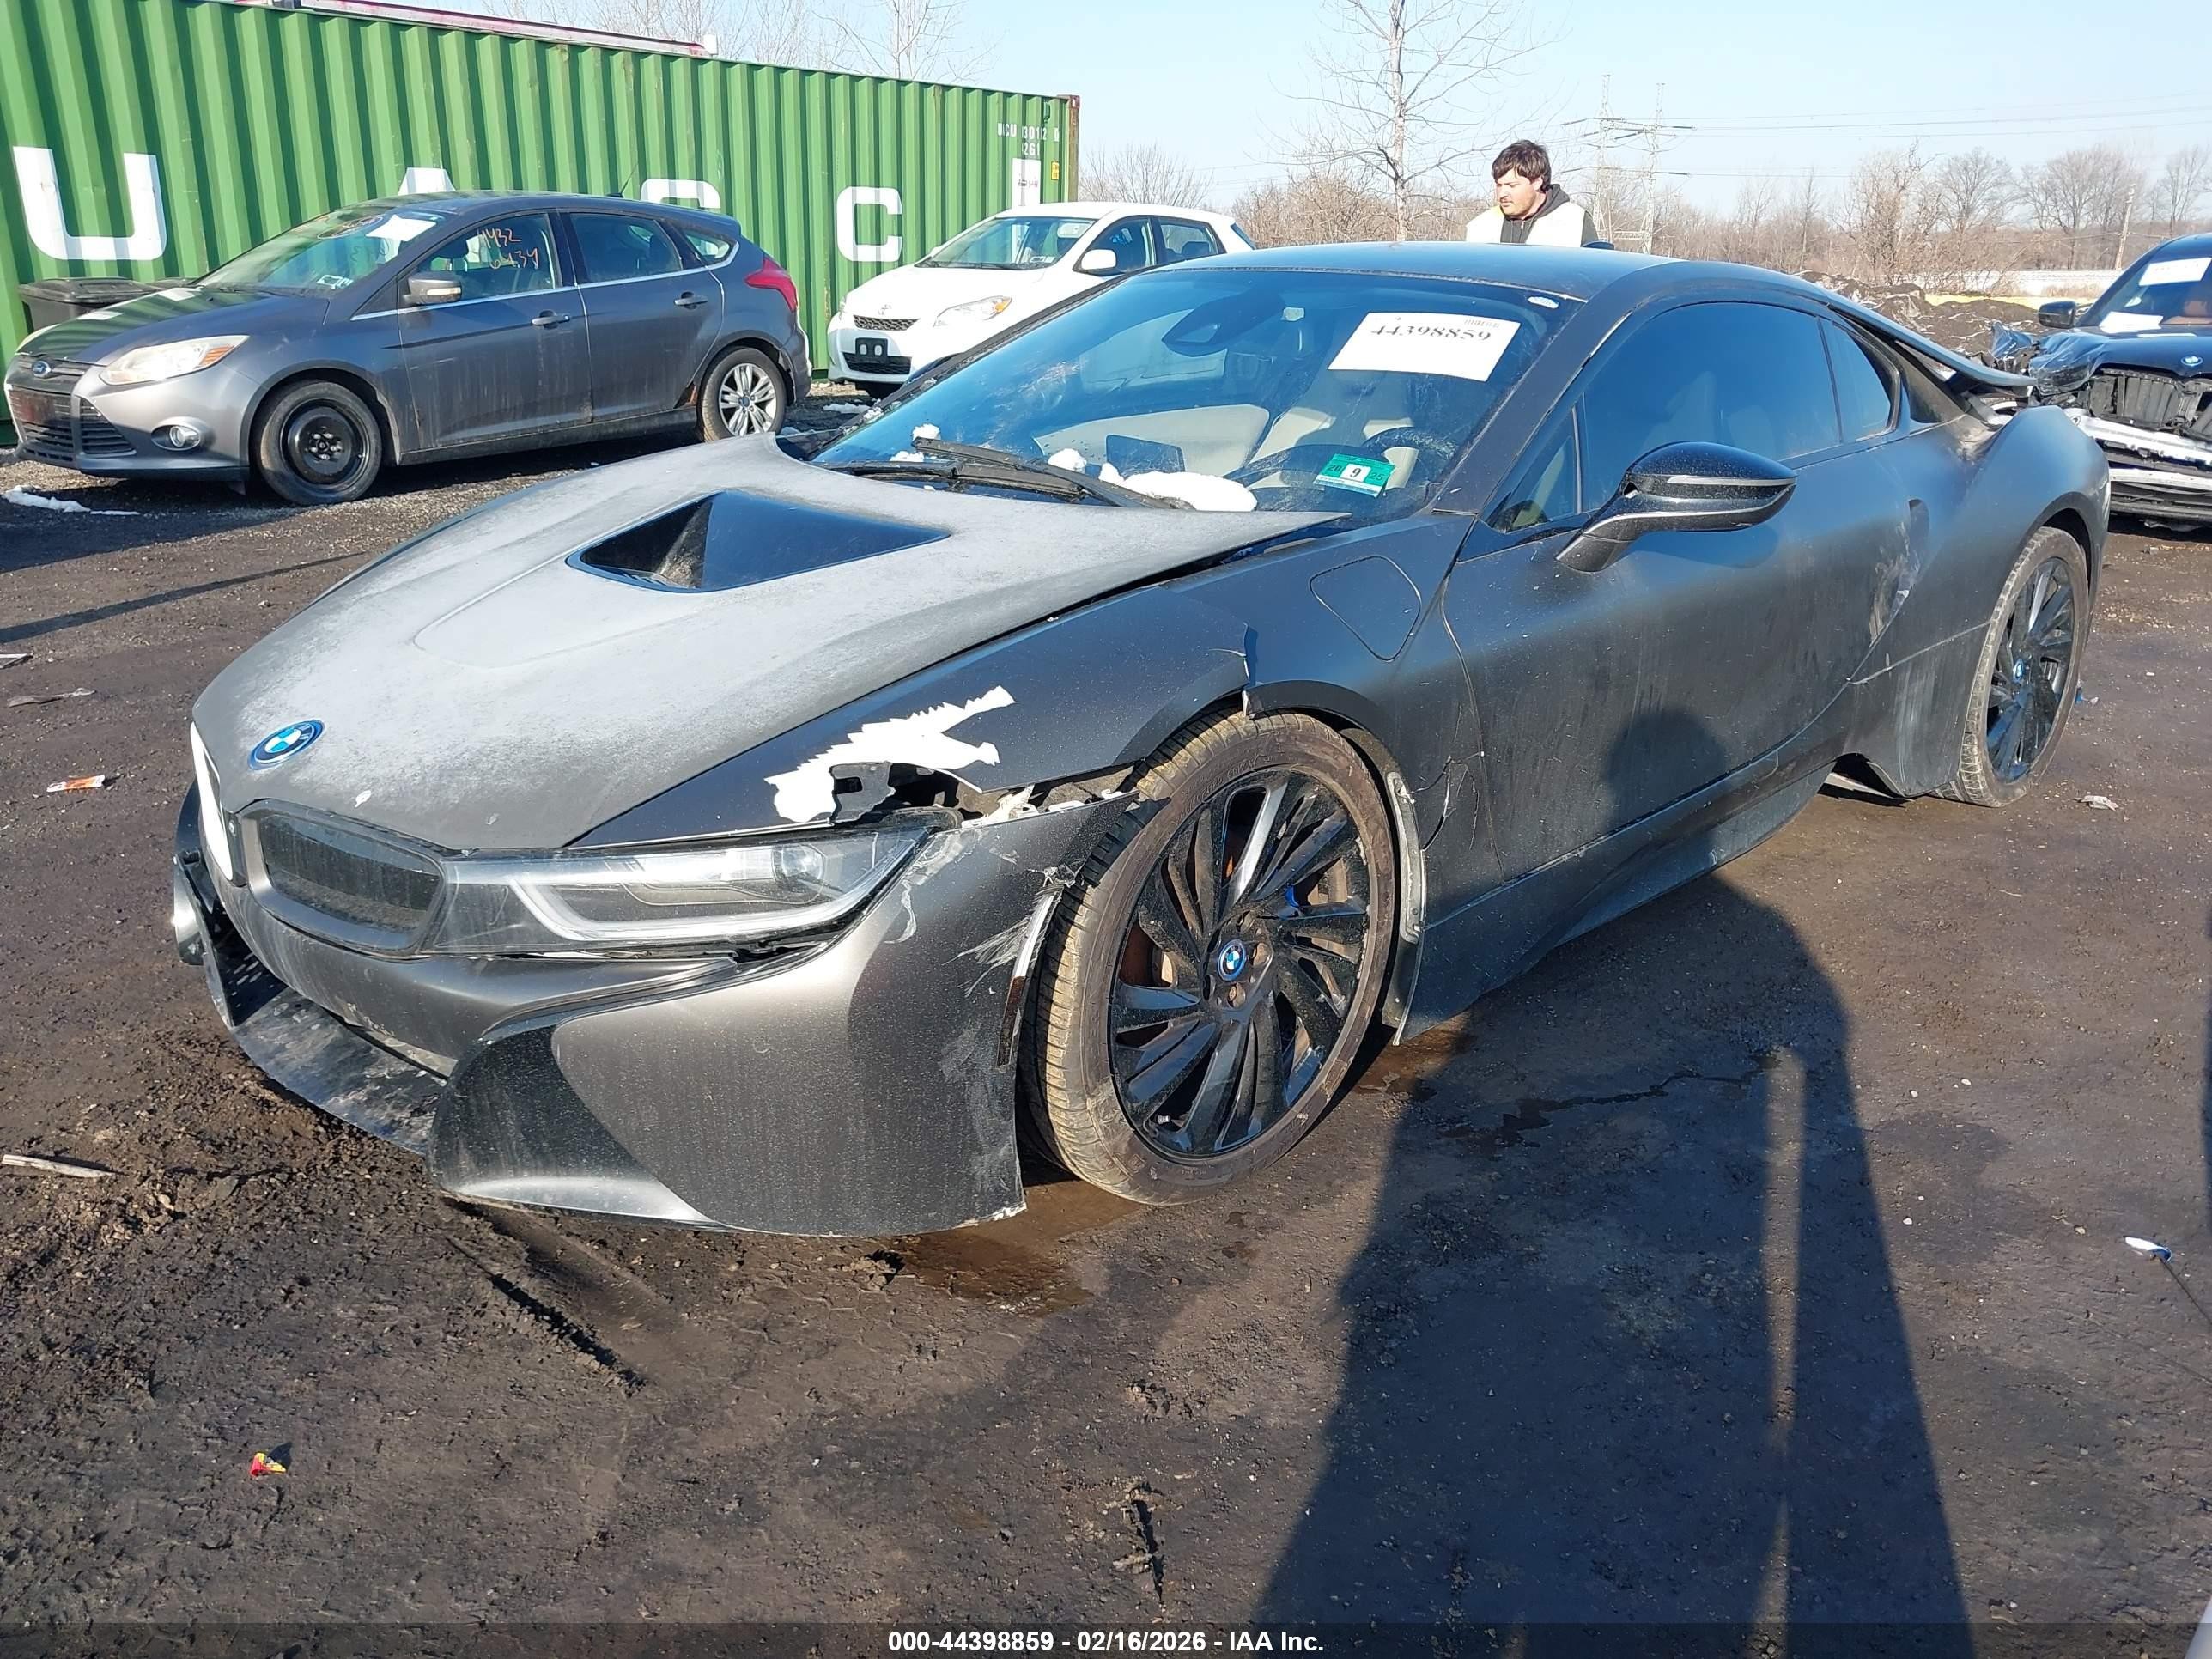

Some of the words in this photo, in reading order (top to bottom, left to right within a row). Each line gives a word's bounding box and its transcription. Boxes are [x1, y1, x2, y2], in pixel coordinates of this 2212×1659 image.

[1371, 325, 1492, 342] 44398859
[1327, 464, 1343, 472] 20
[1350, 467, 1362, 478] 9
[1370, 472, 1384, 481] 25
